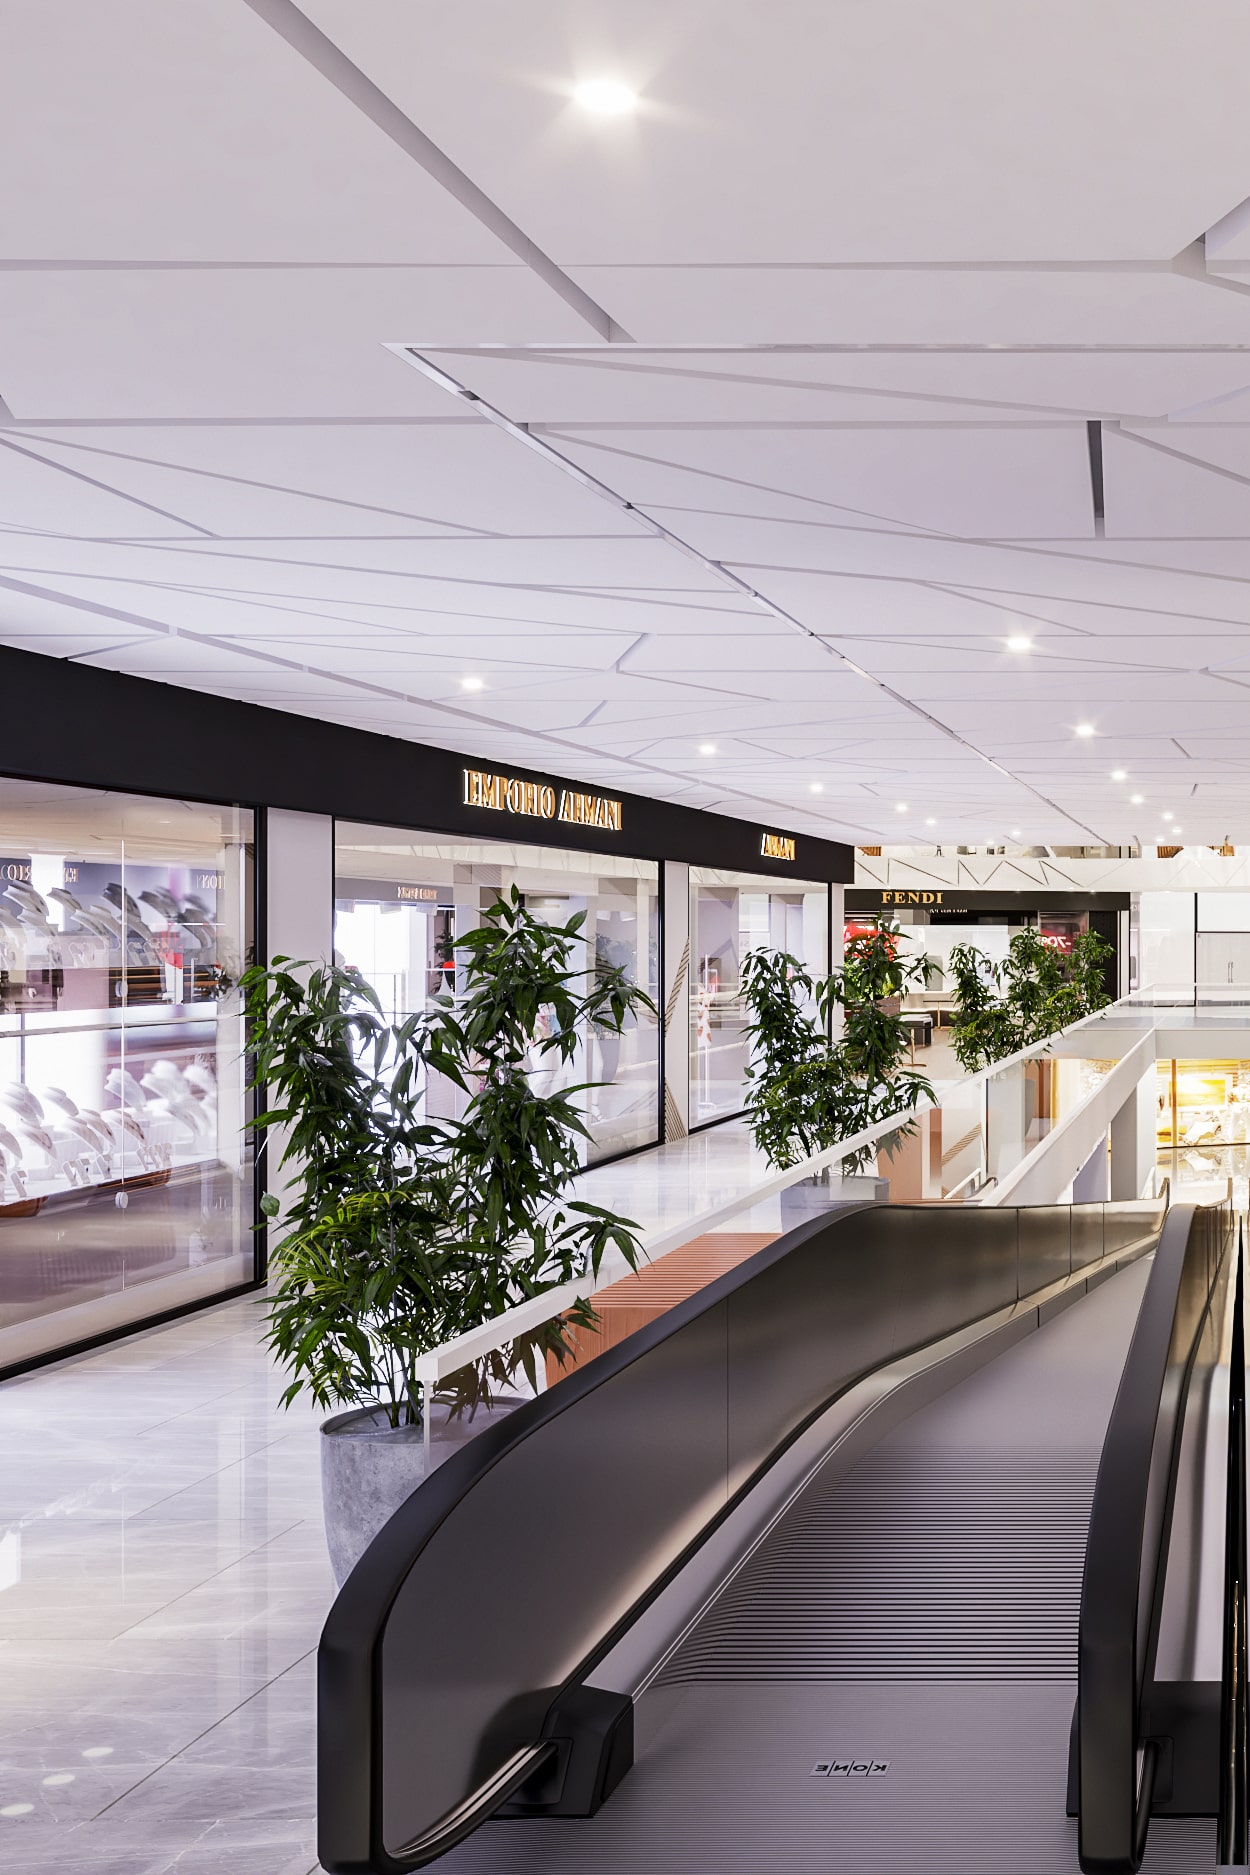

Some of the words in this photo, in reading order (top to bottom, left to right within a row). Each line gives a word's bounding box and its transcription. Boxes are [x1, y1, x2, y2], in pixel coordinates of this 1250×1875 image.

[463, 769, 556, 819] EMPORIO
[558, 789, 623, 831] ARMANI
[881, 891, 944, 904] FENDI
